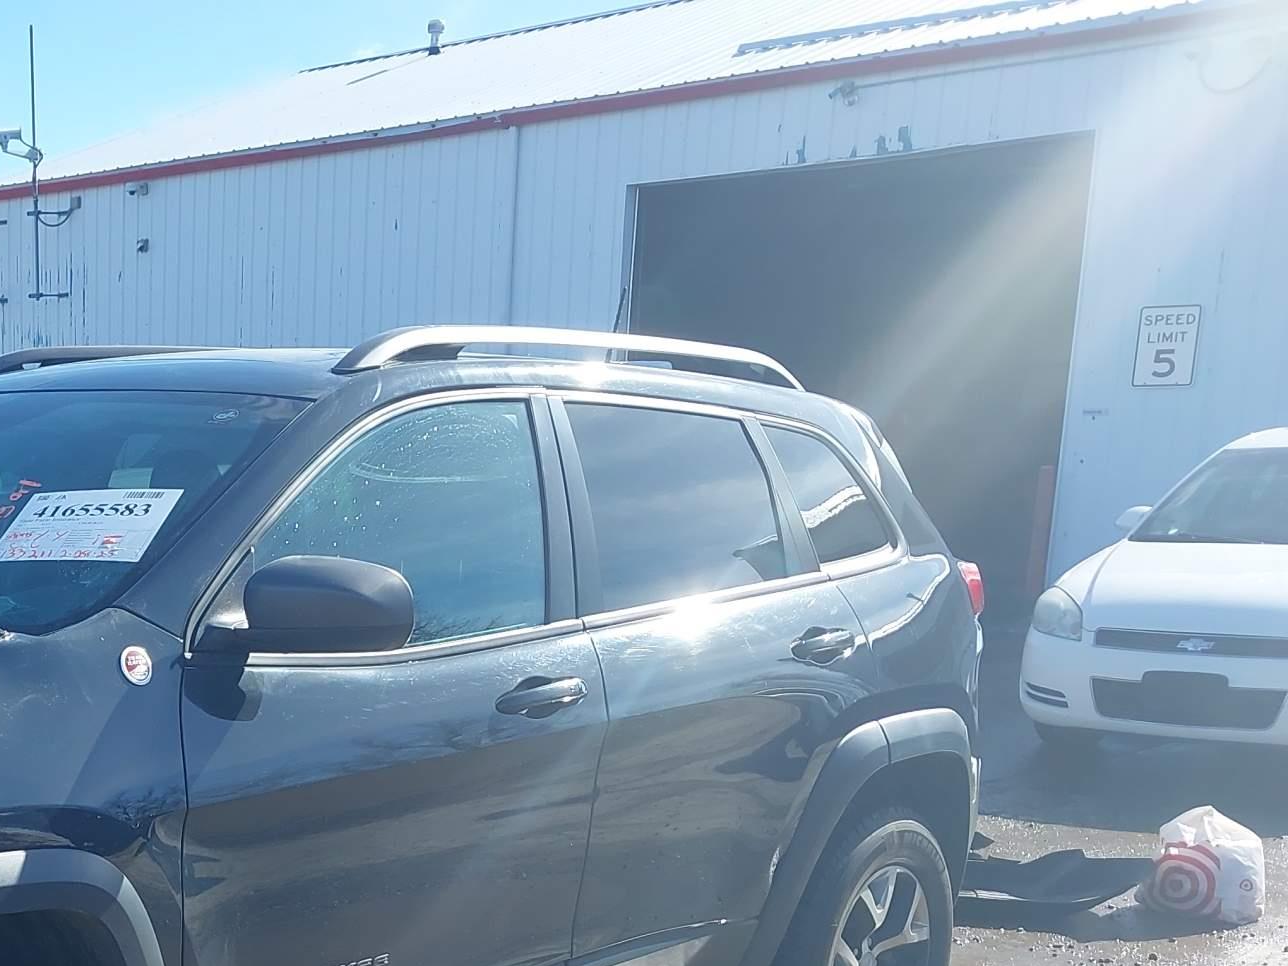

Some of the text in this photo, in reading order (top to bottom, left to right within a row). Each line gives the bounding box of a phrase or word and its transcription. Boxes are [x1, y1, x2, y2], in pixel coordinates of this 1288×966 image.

[1144, 313, 1196, 326] SPEED
[1147, 331, 1188, 344] LIMIT
[1152, 348, 1176, 377] 5
[33, 503, 152, 518] 41655583
